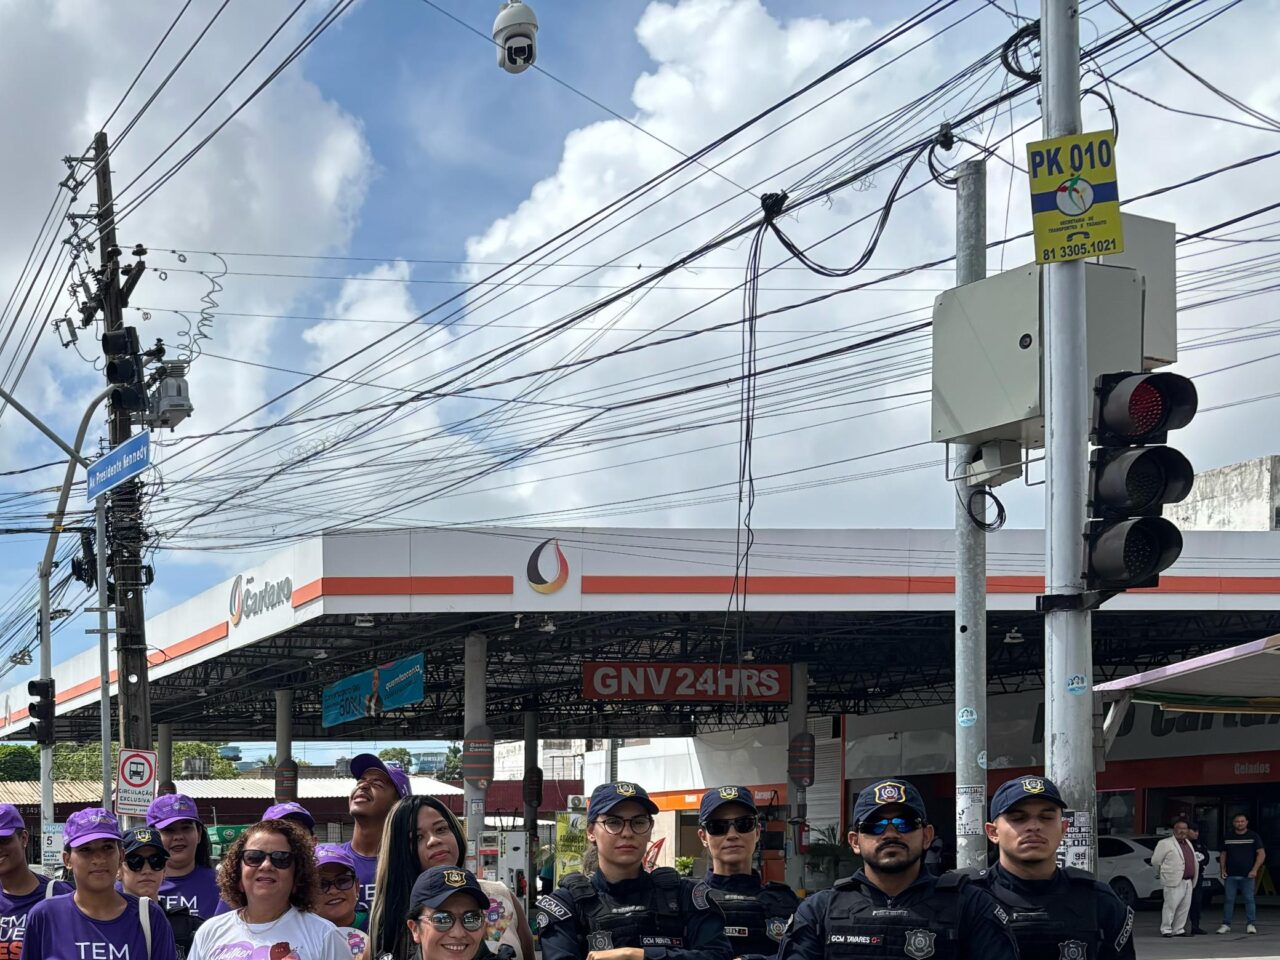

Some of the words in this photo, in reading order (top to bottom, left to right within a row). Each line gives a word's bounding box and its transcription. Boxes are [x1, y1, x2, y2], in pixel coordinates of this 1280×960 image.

[1031, 147, 1064, 178] PK
[1070, 139, 1111, 172] 010
[1043, 248, 1056, 260] 81
[1060, 238, 1117, 258] 3305.1021
[96, 460, 122, 485] Presidente
[122, 445, 148, 468] Kennedy
[243, 577, 293, 619] Cartaxo
[593, 667, 671, 695] GNV
[675, 668, 780, 696] 24HRS
[1234, 762, 1270, 775] Gelados
[118, 788, 153, 796] CIRCULAÇÃO
[540, 898, 565, 916] GCMO
[75, 942, 129, 960] TEM
